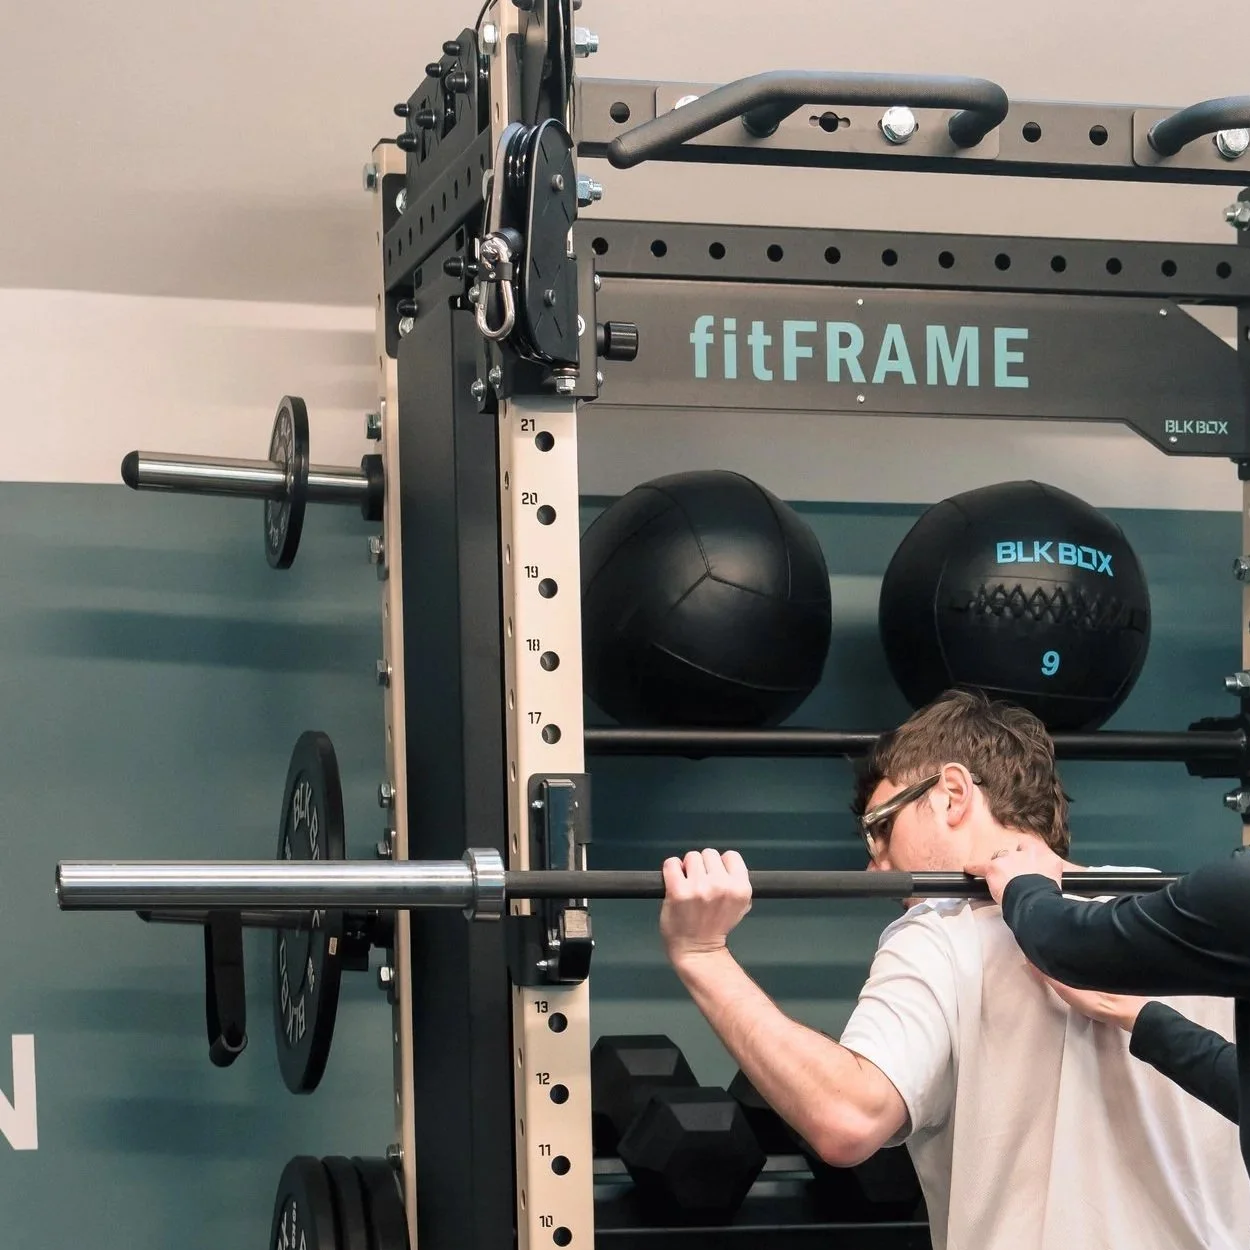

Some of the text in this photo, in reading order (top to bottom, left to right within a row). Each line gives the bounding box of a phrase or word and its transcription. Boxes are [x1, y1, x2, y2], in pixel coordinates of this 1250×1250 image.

[690, 315, 1029, 388] fitFRAME
[521, 418, 535, 431] 21
[1165, 419, 1228, 434] BLK BOX
[522, 492, 538, 505] 20
[996, 540, 1114, 577] BLK BOX
[524, 566, 538, 578] 19
[526, 639, 540, 651] 18
[1041, 650, 1061, 676] 9
[528, 712, 541, 724] 17
[293, 781, 312, 831] BLK
[535, 1001, 549, 1013] 13
[536, 1073, 550, 1085] 12
[539, 1144, 551, 1156] 11
[539, 1215, 553, 1227] 10
